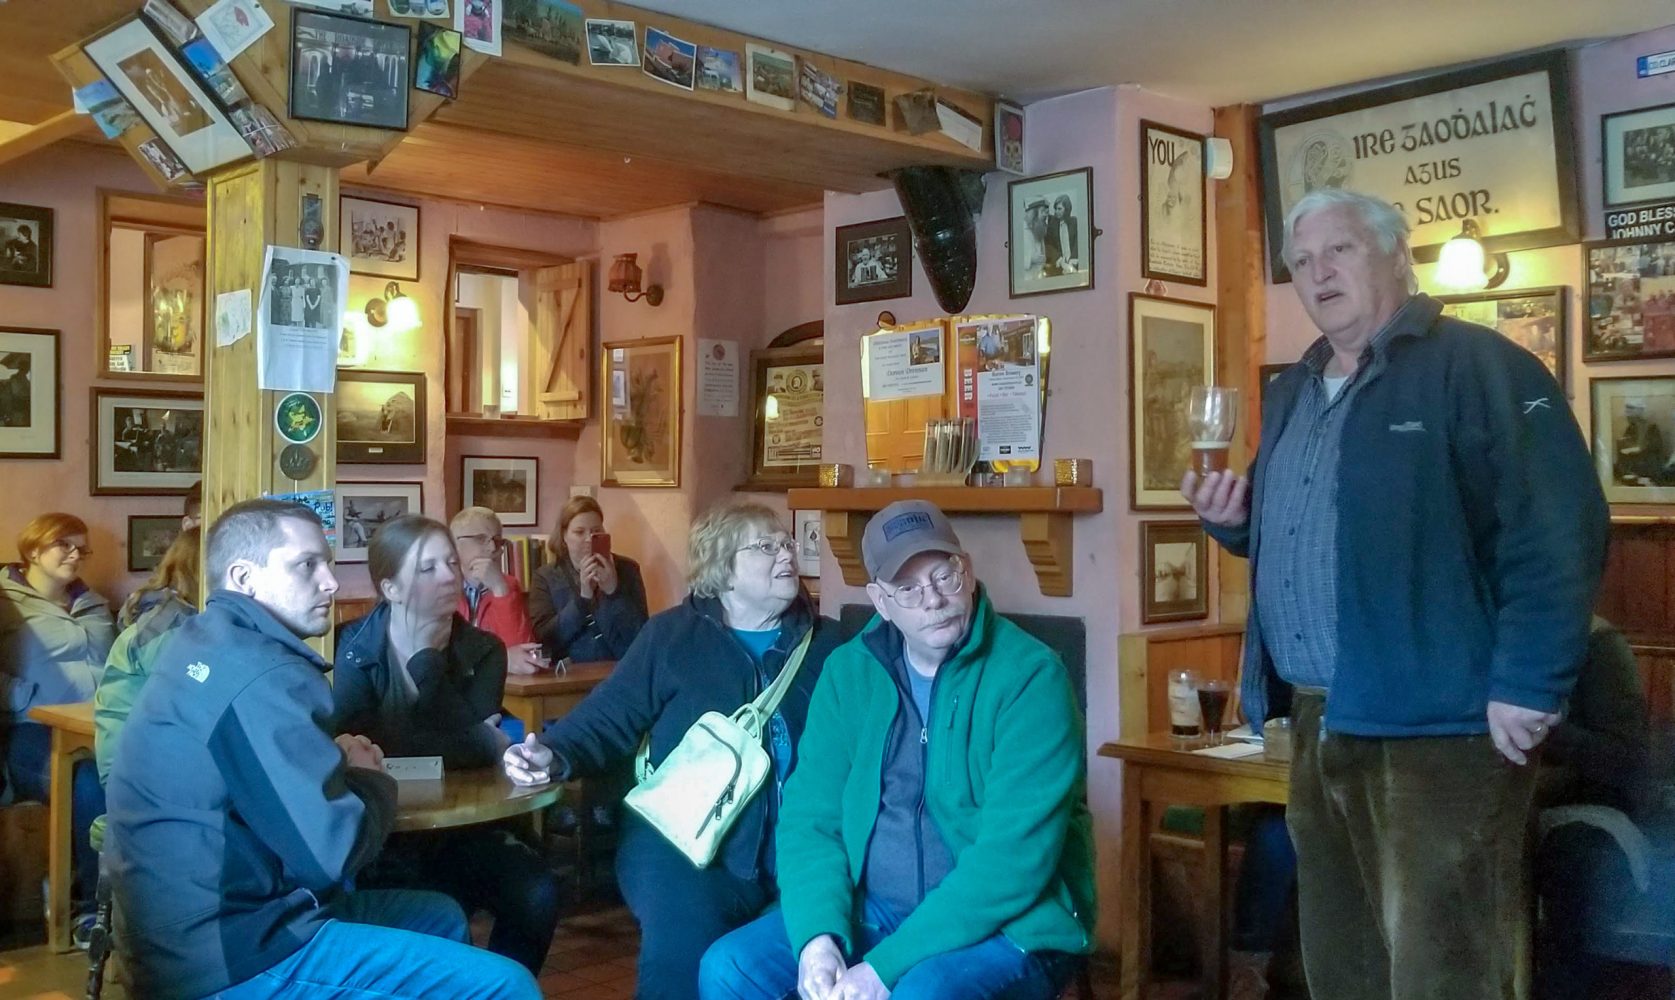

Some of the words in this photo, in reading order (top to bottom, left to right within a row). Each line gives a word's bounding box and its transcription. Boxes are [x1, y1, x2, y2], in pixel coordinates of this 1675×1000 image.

[1148, 136, 1175, 168] YOU
[1608, 212, 1636, 227] GOD
[1639, 206, 1675, 223] BLES
[1665, 221, 1675, 234] C
